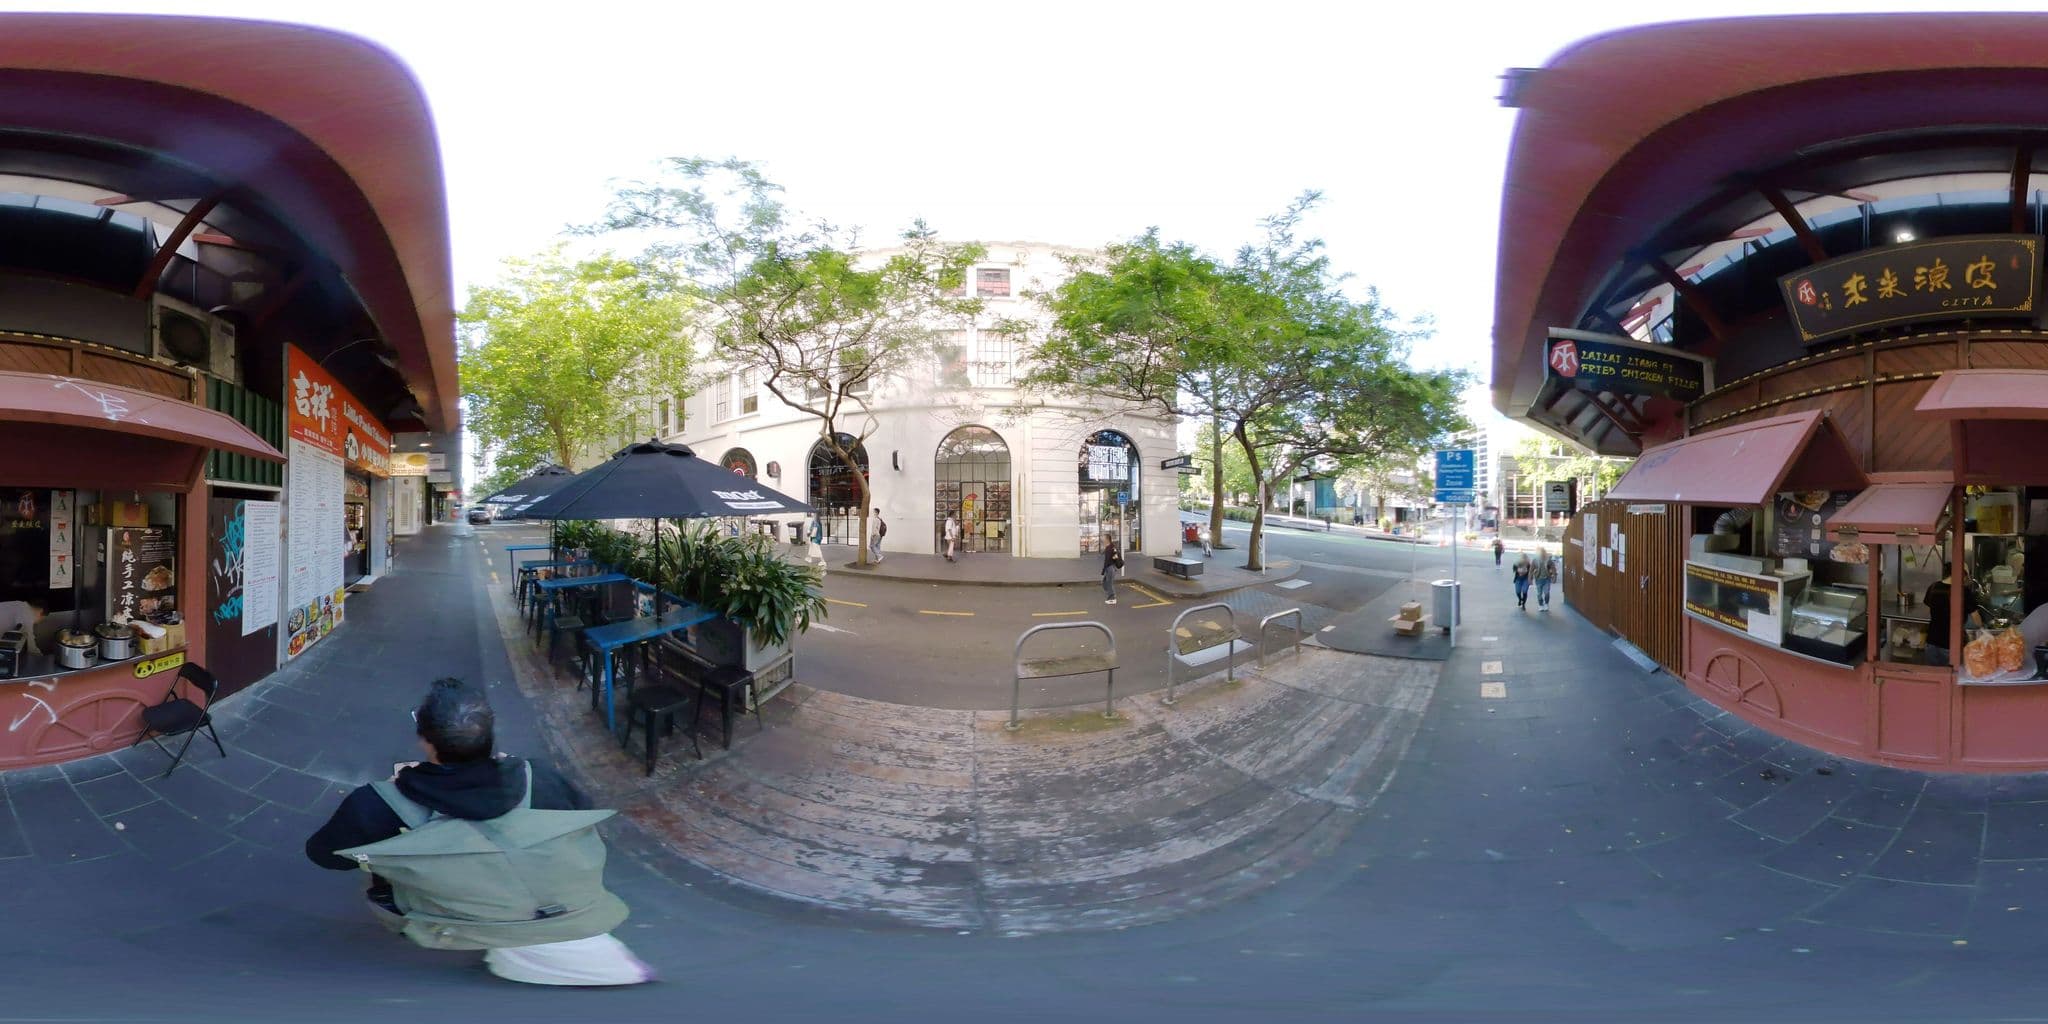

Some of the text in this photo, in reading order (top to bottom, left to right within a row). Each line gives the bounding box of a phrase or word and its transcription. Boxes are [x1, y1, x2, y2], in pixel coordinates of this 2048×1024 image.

[1581, 363, 1616, 375] FRIED
[1621, 368, 1663, 382] CHICKEN
[292, 370, 334, 433] 吉祥
